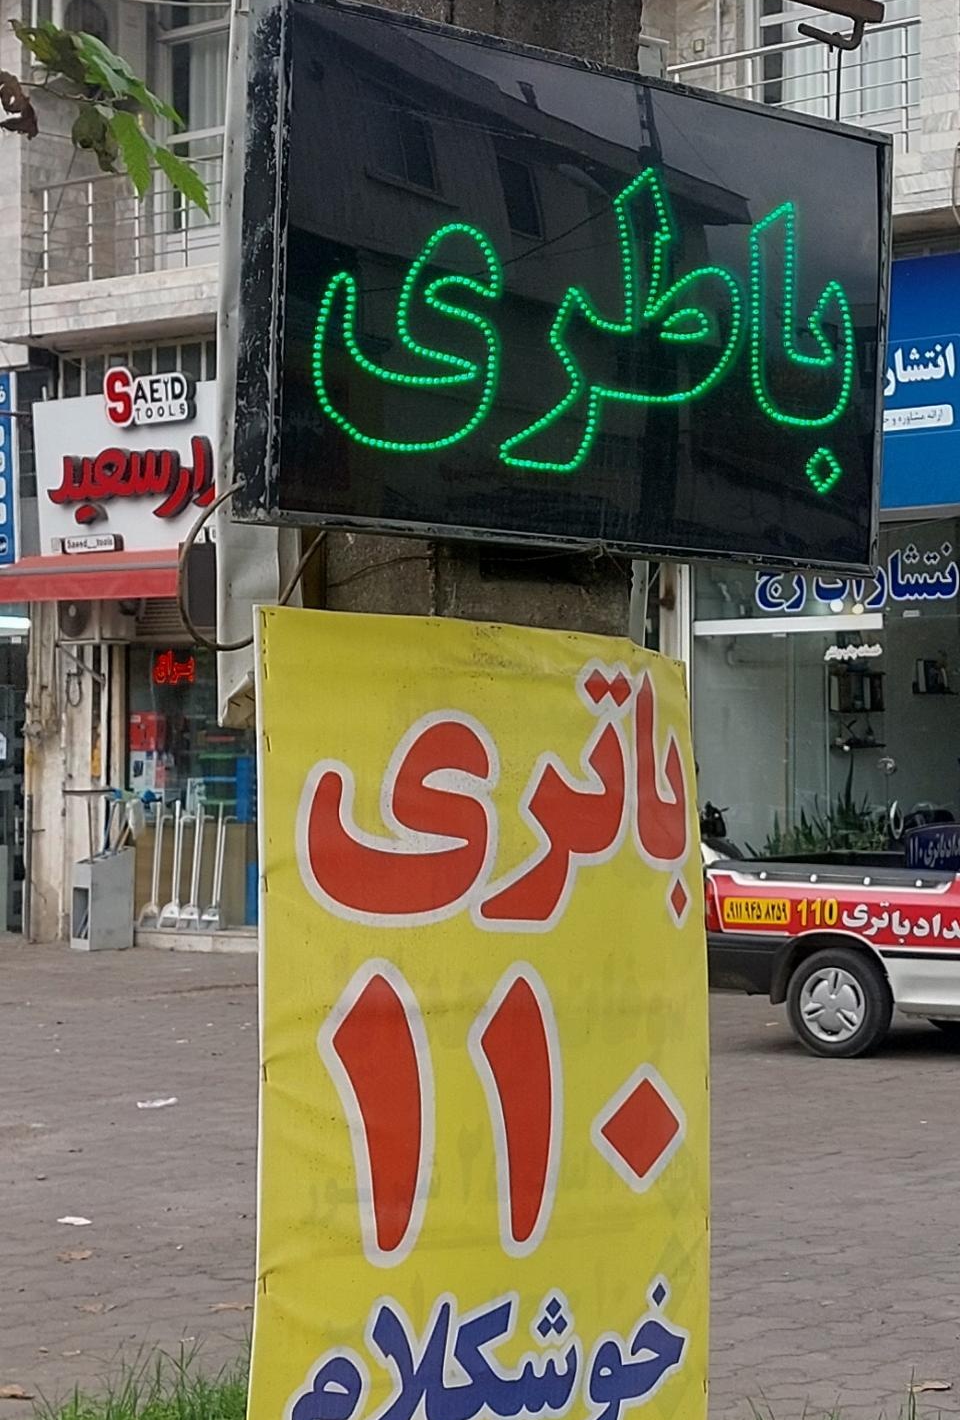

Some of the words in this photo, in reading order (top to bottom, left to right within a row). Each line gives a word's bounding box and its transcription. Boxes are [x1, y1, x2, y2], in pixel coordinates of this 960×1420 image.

[106, 370, 185, 424] SAEID
[313, 167, 853, 493] باطری
[134, 403, 186, 419] TOOLS
[300, 660, 692, 928] باتری
[796, 897, 839, 926] 110
[322, 960, 685, 1266] ۱۱۰
